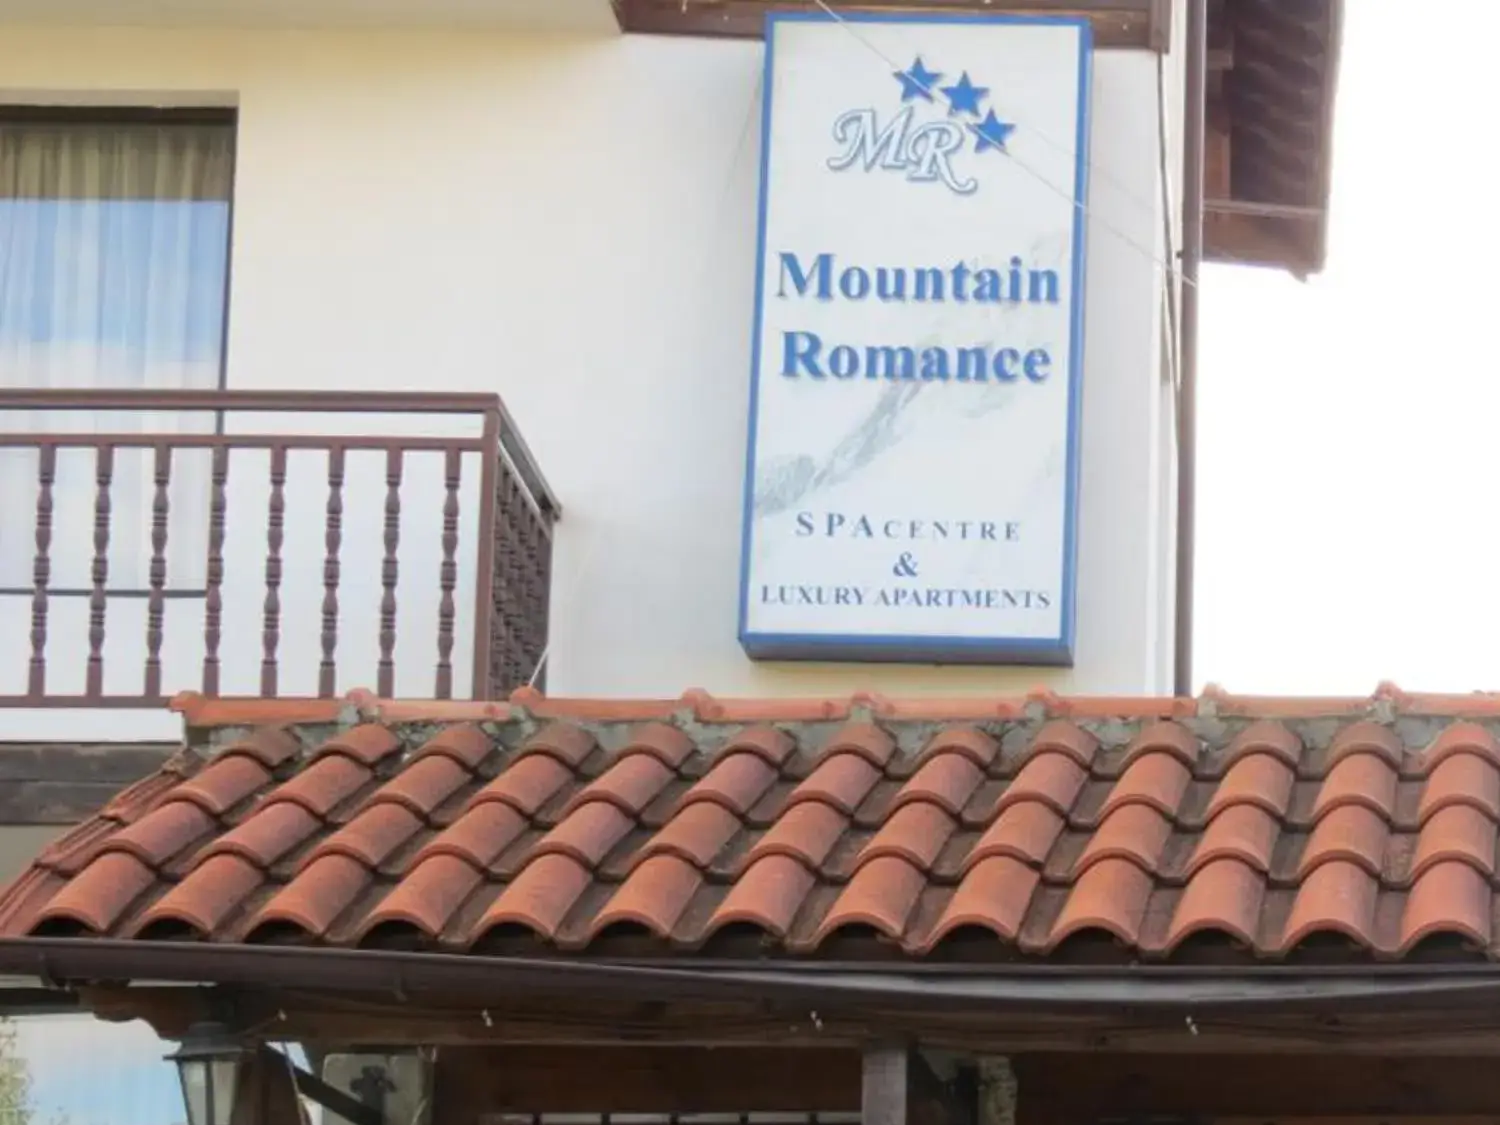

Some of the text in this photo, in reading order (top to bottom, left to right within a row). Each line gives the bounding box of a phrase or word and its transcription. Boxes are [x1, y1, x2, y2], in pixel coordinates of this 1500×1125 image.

[775, 251, 1060, 304] Mountain
[780, 330, 1052, 382] Romance
[892, 551, 919, 577] &
[761, 585, 1051, 609] LUXURY APARTMENTS
